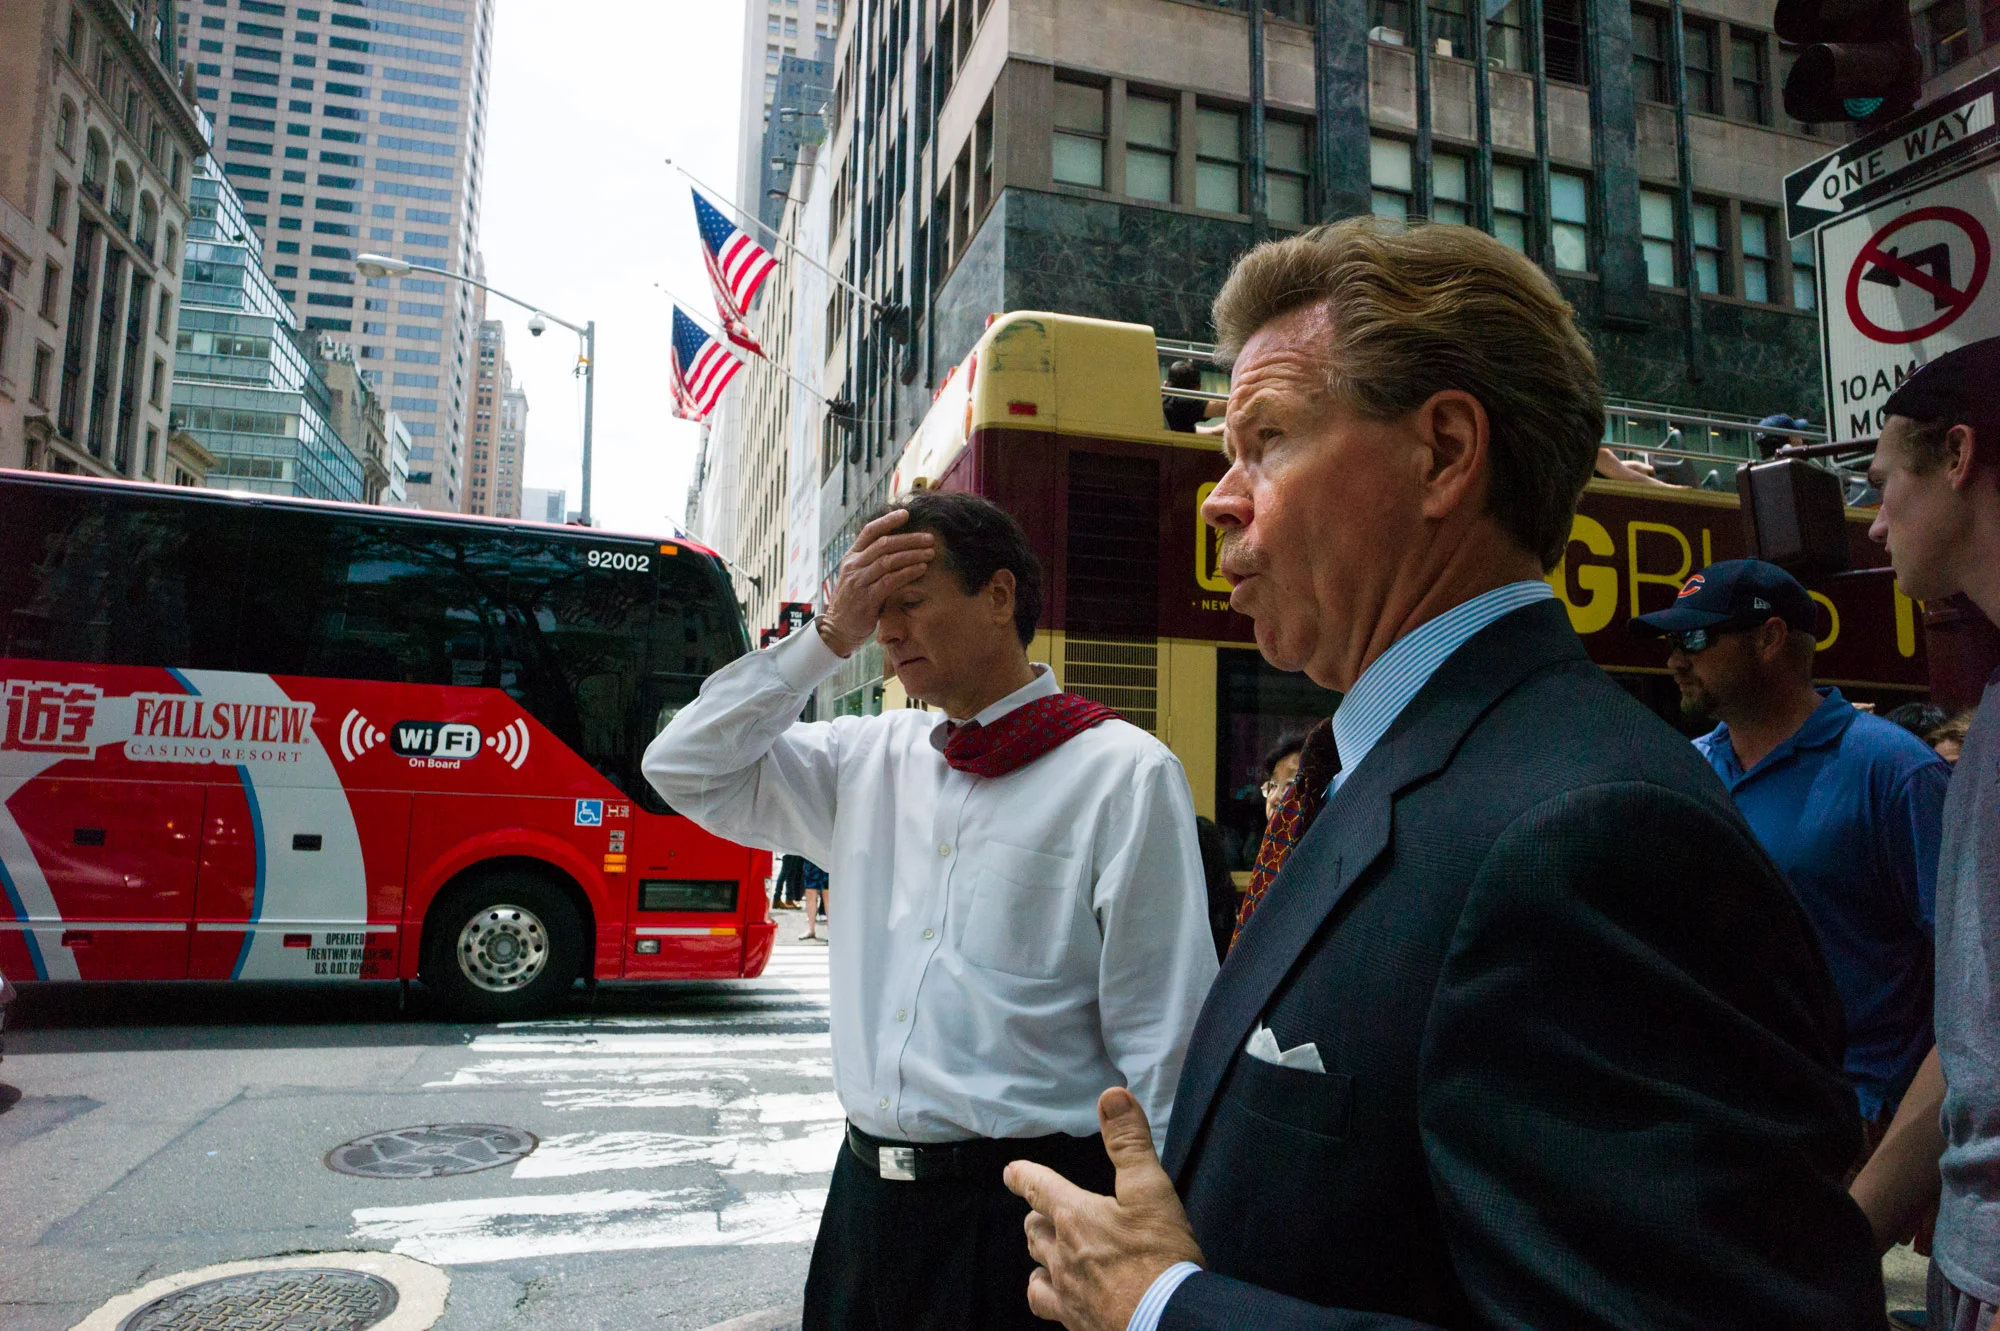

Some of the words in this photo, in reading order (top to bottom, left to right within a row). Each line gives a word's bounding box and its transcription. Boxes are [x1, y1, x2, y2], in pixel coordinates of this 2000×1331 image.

[1822, 151, 1886, 200] ONE
[1903, 104, 1978, 161] WAY
[587, 550, 650, 572] 92002
[1202, 599, 1230, 611] NEW
[134, 698, 310, 744] FALLSVIEW
[130, 744, 211, 759] CASINO
[222, 748, 302, 763] RESORT
[409, 758, 425, 769] On
[427, 759, 460, 770] Board
[326, 932, 365, 946] OPERATED
